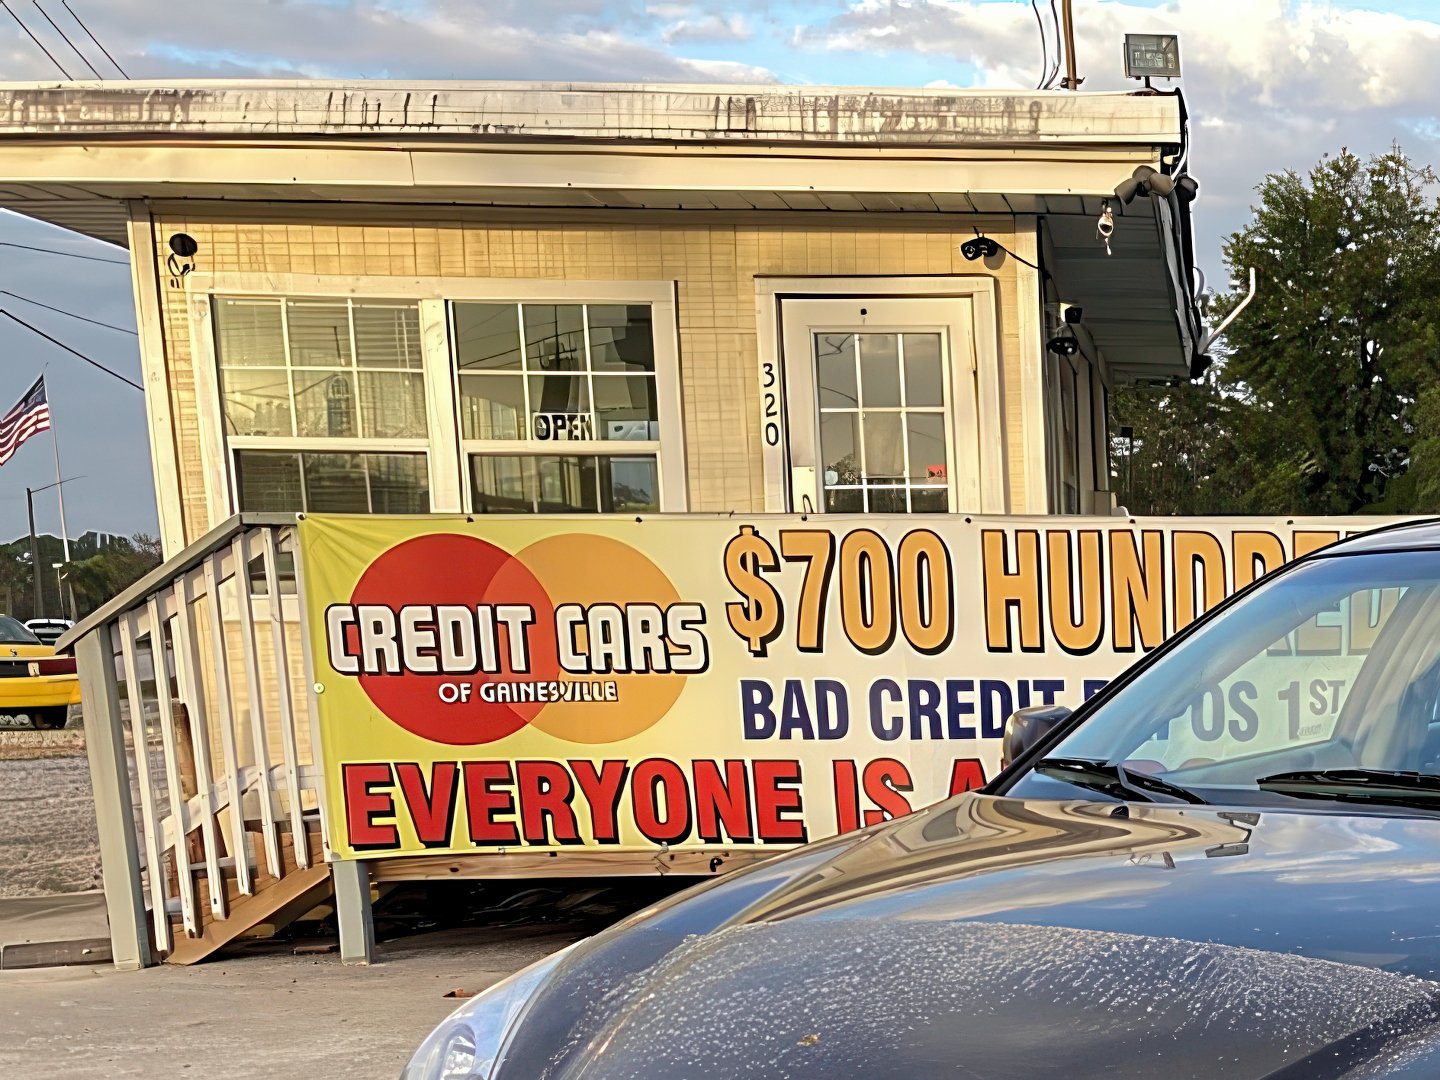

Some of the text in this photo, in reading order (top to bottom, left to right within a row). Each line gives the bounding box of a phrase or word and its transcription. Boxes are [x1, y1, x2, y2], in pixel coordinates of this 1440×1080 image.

[534, 414, 594, 441] OPEN
[762, 362, 780, 447] 320
[723, 525, 956, 658] $700
[325, 602, 711, 676] CREDIT CARS
[438, 680, 618, 704] OF GAINESVILLE
[740, 678, 850, 740] BAD
[342, 757, 808, 851] EVERYONE
[832, 757, 914, 836] IS
